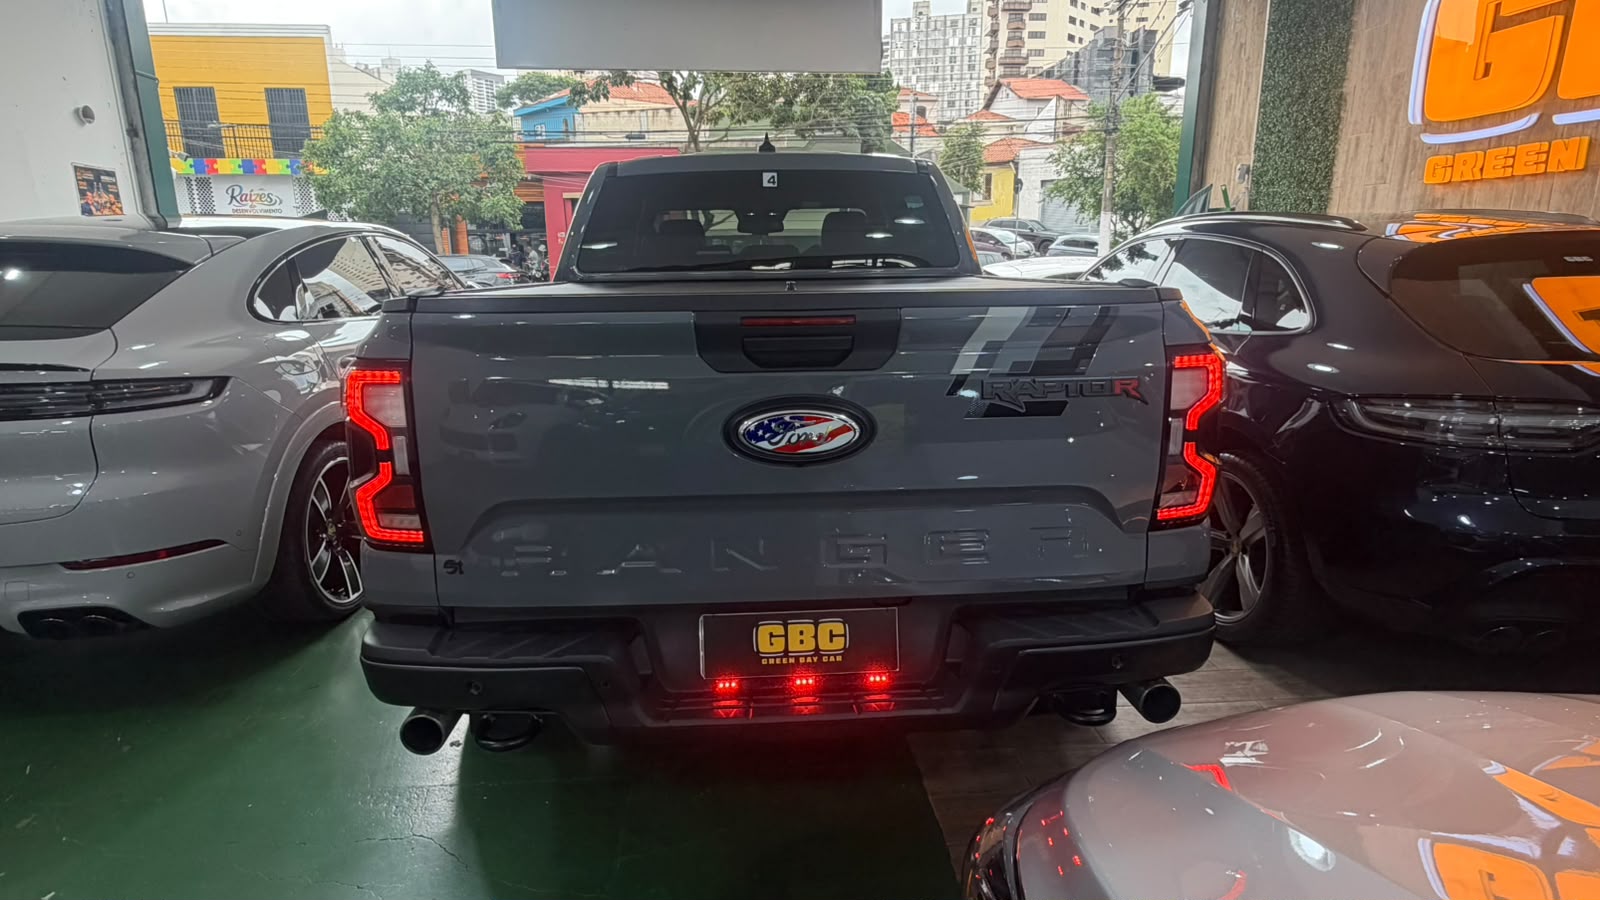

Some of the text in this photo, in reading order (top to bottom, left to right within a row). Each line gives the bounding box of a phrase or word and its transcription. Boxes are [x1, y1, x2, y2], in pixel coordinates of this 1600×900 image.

[1424, 136, 1591, 184] GREEN
[767, 175, 777, 186] 4
[226, 184, 278, 206] Raízes
[981, 377, 1149, 412] RAPTOR
[765, 419, 833, 446] Ford
[757, 621, 846, 654] GBC
[761, 657, 795, 665] GREEN
